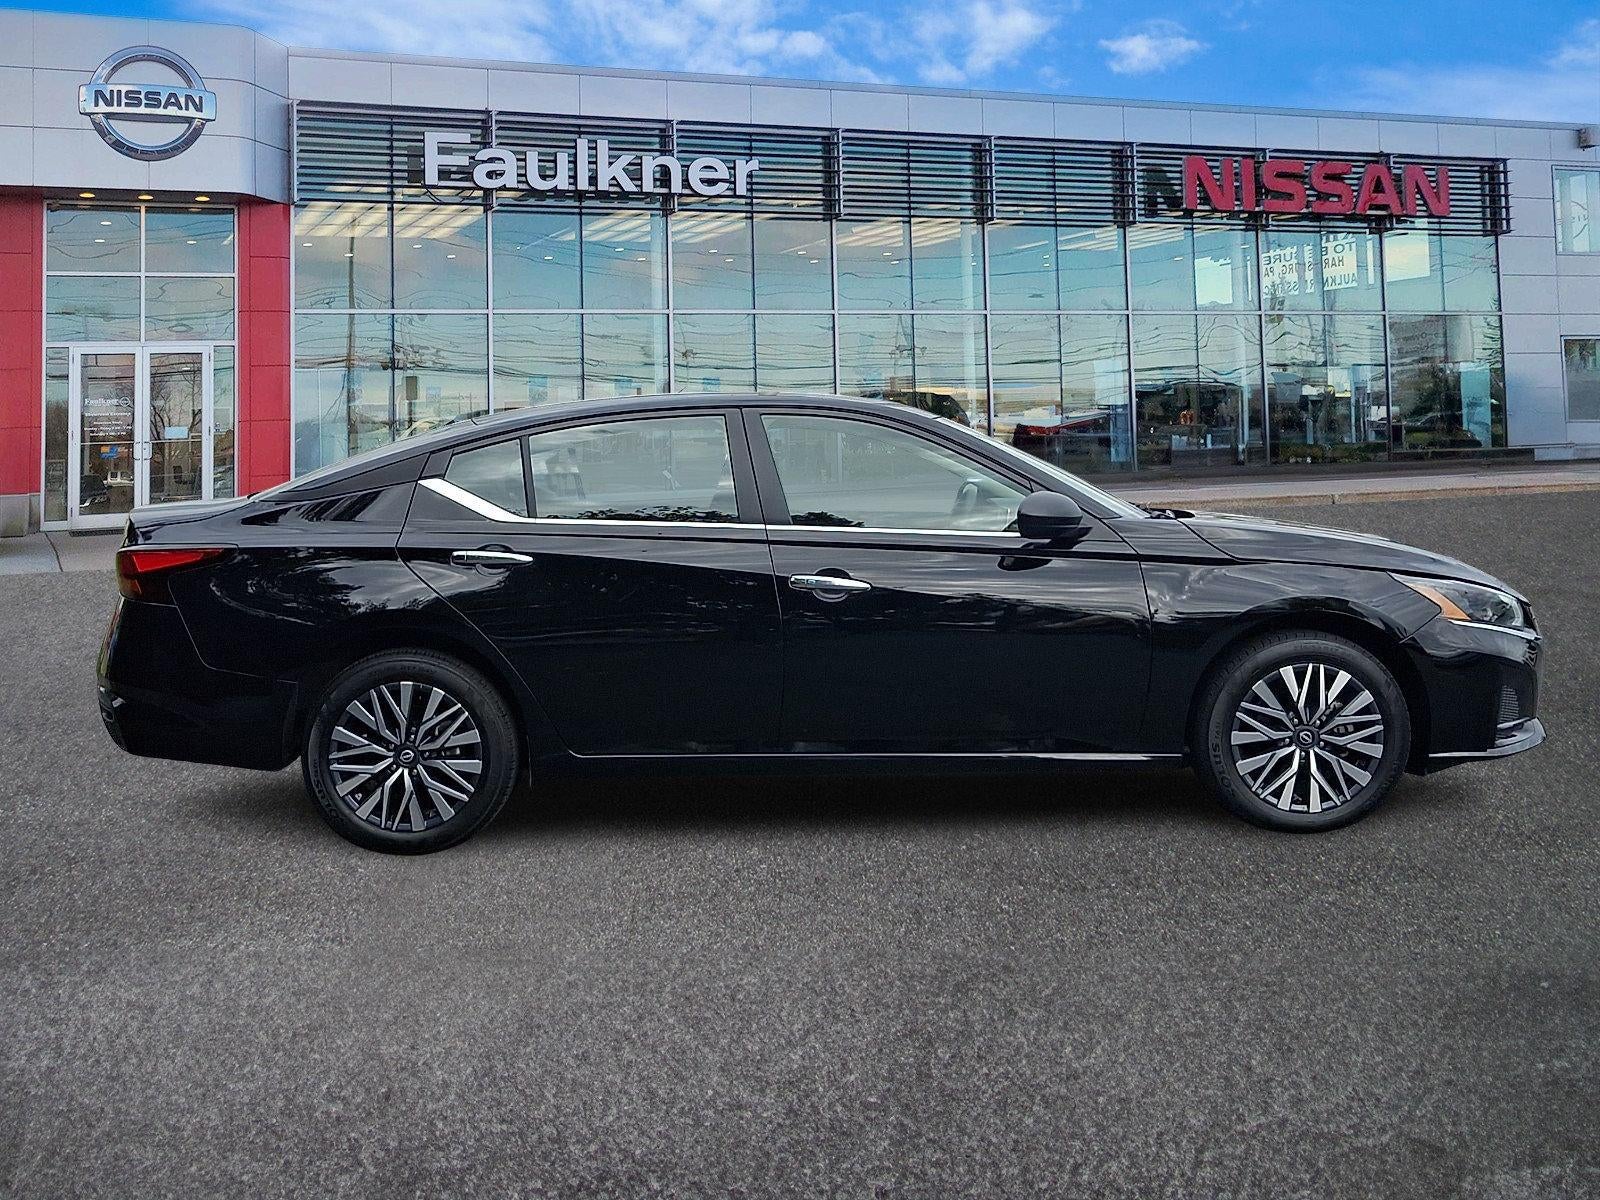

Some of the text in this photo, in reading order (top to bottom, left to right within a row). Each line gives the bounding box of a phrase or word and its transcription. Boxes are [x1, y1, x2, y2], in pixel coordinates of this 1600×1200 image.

[94, 89, 203, 113] NISSAN
[423, 131, 760, 196] Faulkner
[1182, 155, 1450, 216] NISSAN
